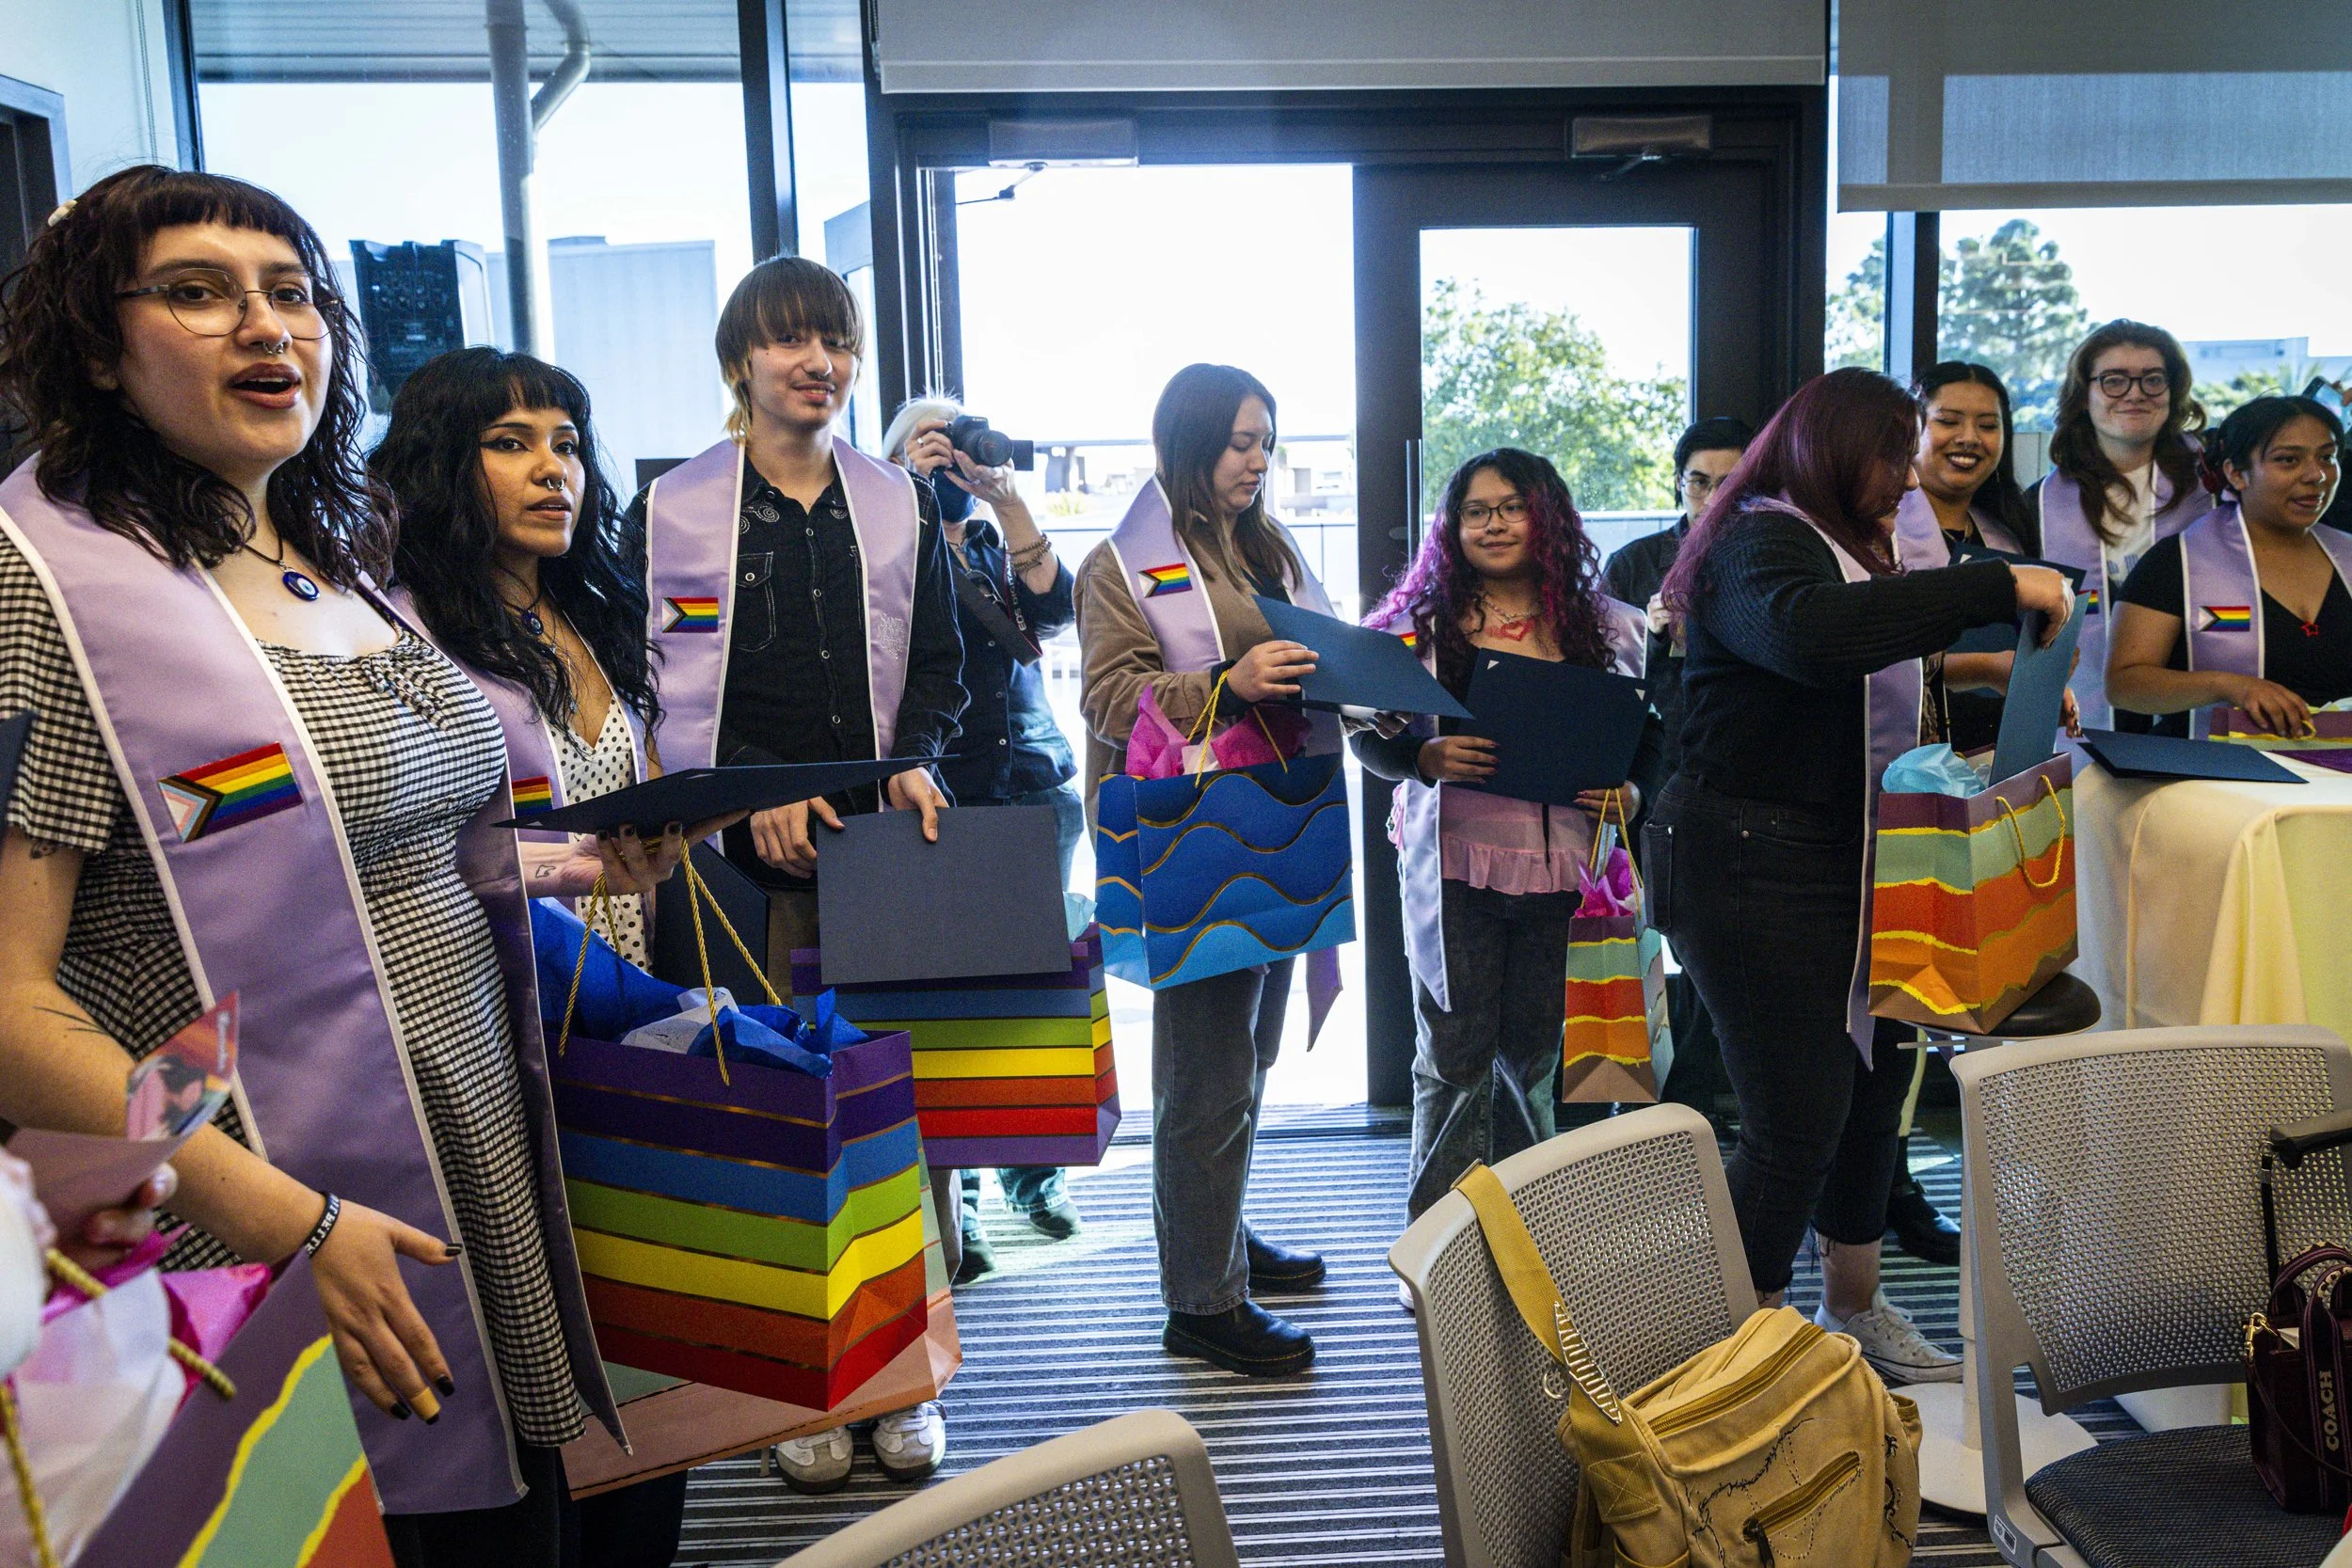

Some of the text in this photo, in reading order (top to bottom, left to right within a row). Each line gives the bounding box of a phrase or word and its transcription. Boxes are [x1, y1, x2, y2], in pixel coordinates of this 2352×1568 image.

[1007, 561, 1026, 631] EOS DIGITAL
[2318, 1370, 2341, 1452] COACH
